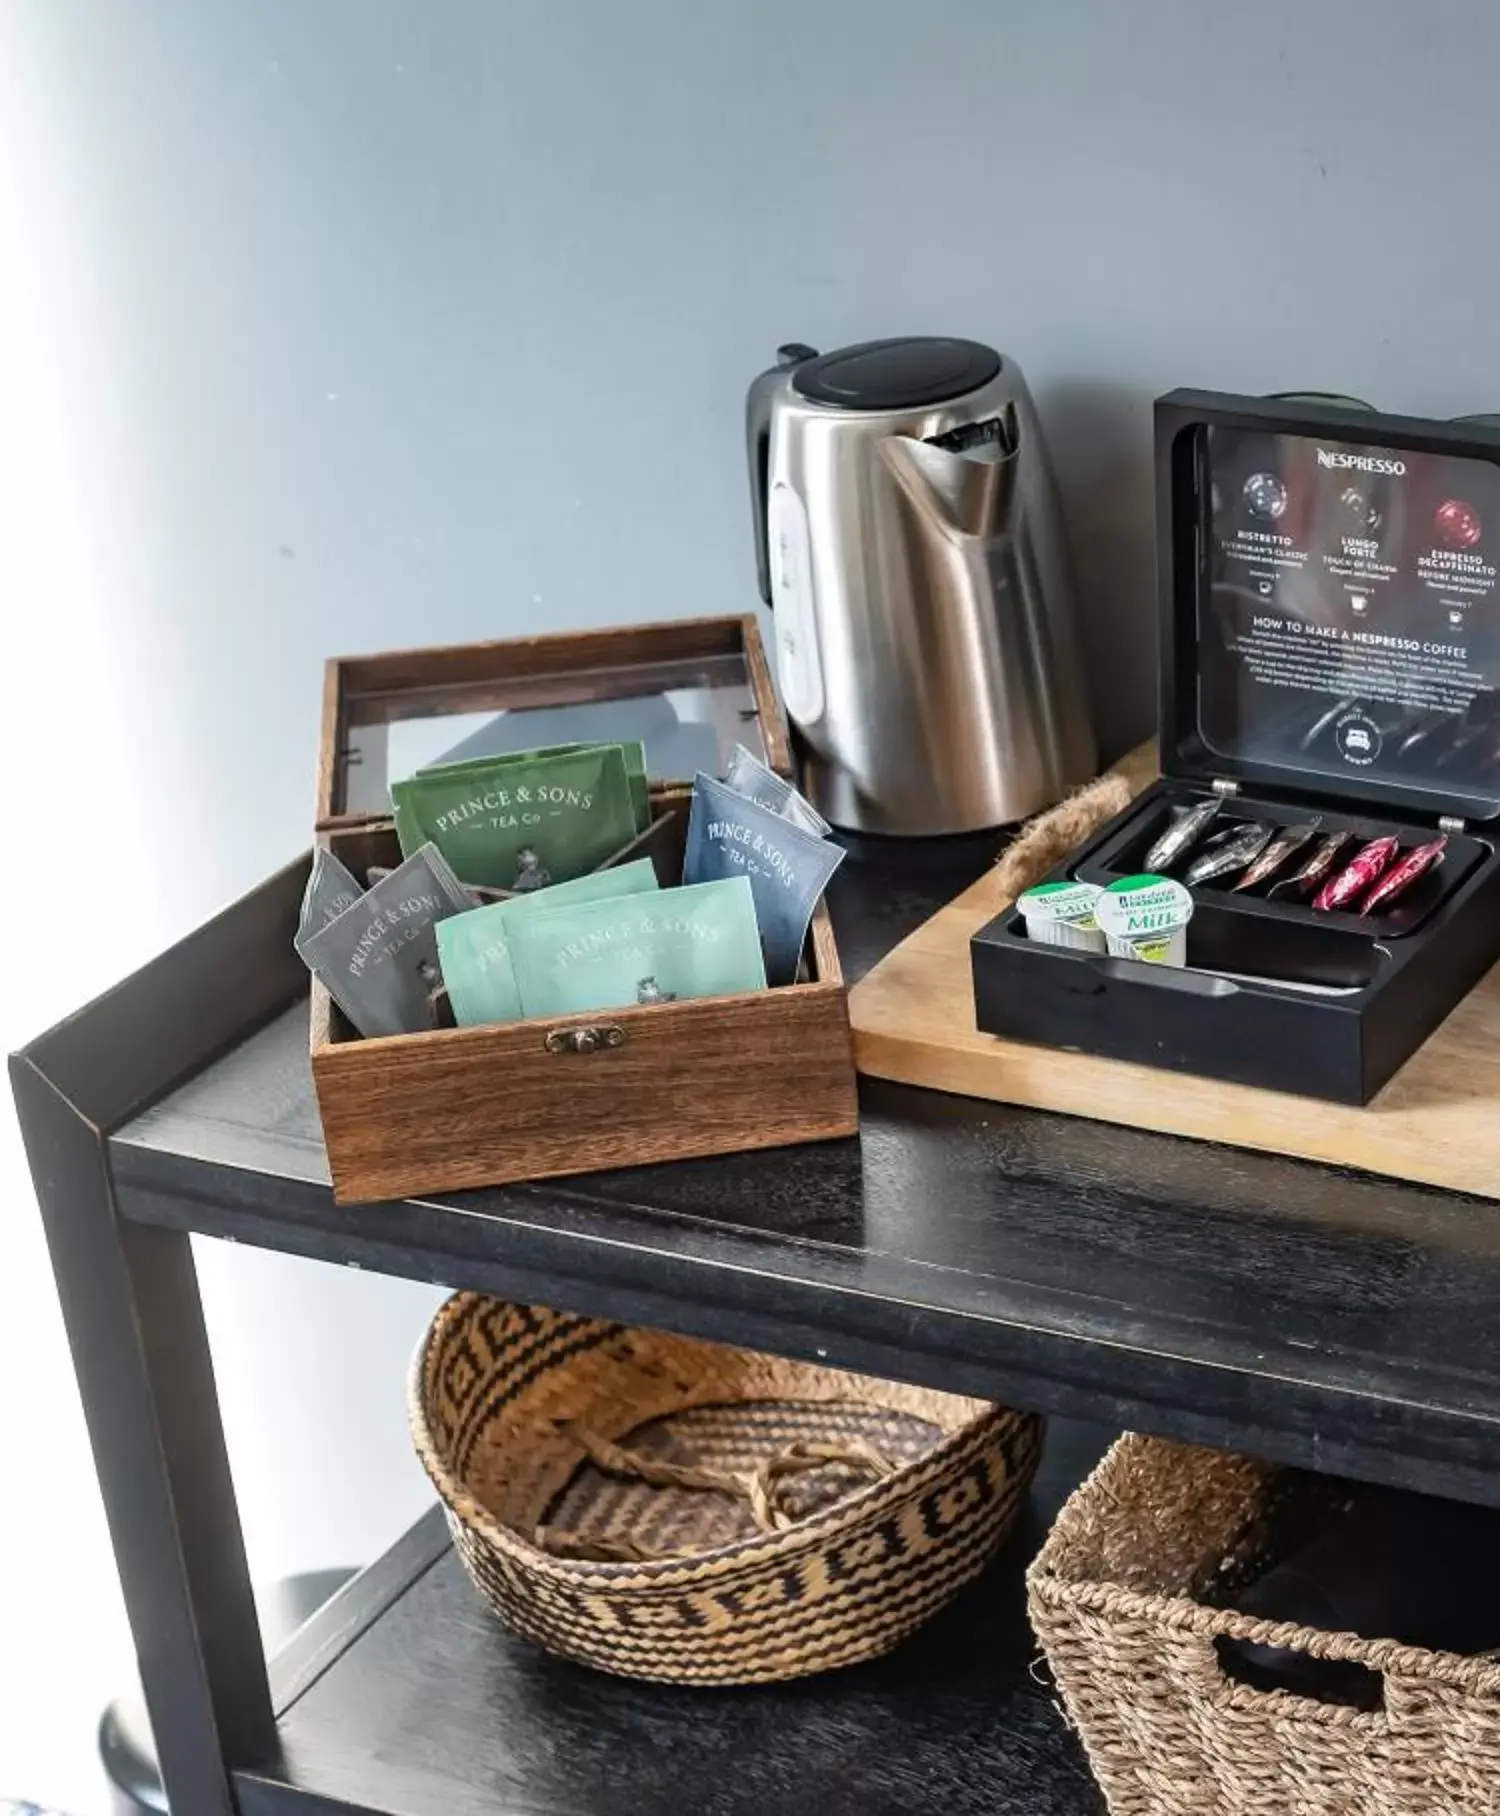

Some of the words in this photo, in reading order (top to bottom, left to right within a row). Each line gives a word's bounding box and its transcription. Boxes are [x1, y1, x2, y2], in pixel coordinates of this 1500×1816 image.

[1316, 448, 1406, 476] NESPRESSO
[1237, 530, 1293, 547] RISTRETTO
[1341, 535, 1378, 550] LUNGO
[1343, 546, 1377, 559] FORTE
[1432, 549, 1483, 565] ESPRESSO
[1417, 557, 1497, 577] DECAFFEINATO
[1253, 616, 1283, 631] HOW
[1285, 620, 1301, 634] TO
[1305, 624, 1338, 640] MAKE
[1341, 630, 1350, 640] A
[1353, 631, 1419, 651] NESPRESSO
[1423, 641, 1467, 659] COFFEE
[434, 789, 512, 832] PRINCE
[515, 785, 533, 804] &
[537, 785, 593, 811] SONS
[489, 814, 518, 829] TEA
[707, 821, 752, 845] PRINCE
[751, 833, 765, 853] &
[763, 843, 795, 889] SONS
[1126, 910, 1179, 931] Milk
[349, 917, 389, 978] PRINCE
[385, 907, 400, 926] &
[555, 921, 633, 969] PRINCE
[639, 917, 656, 933] &
[659, 917, 719, 943] SONS
